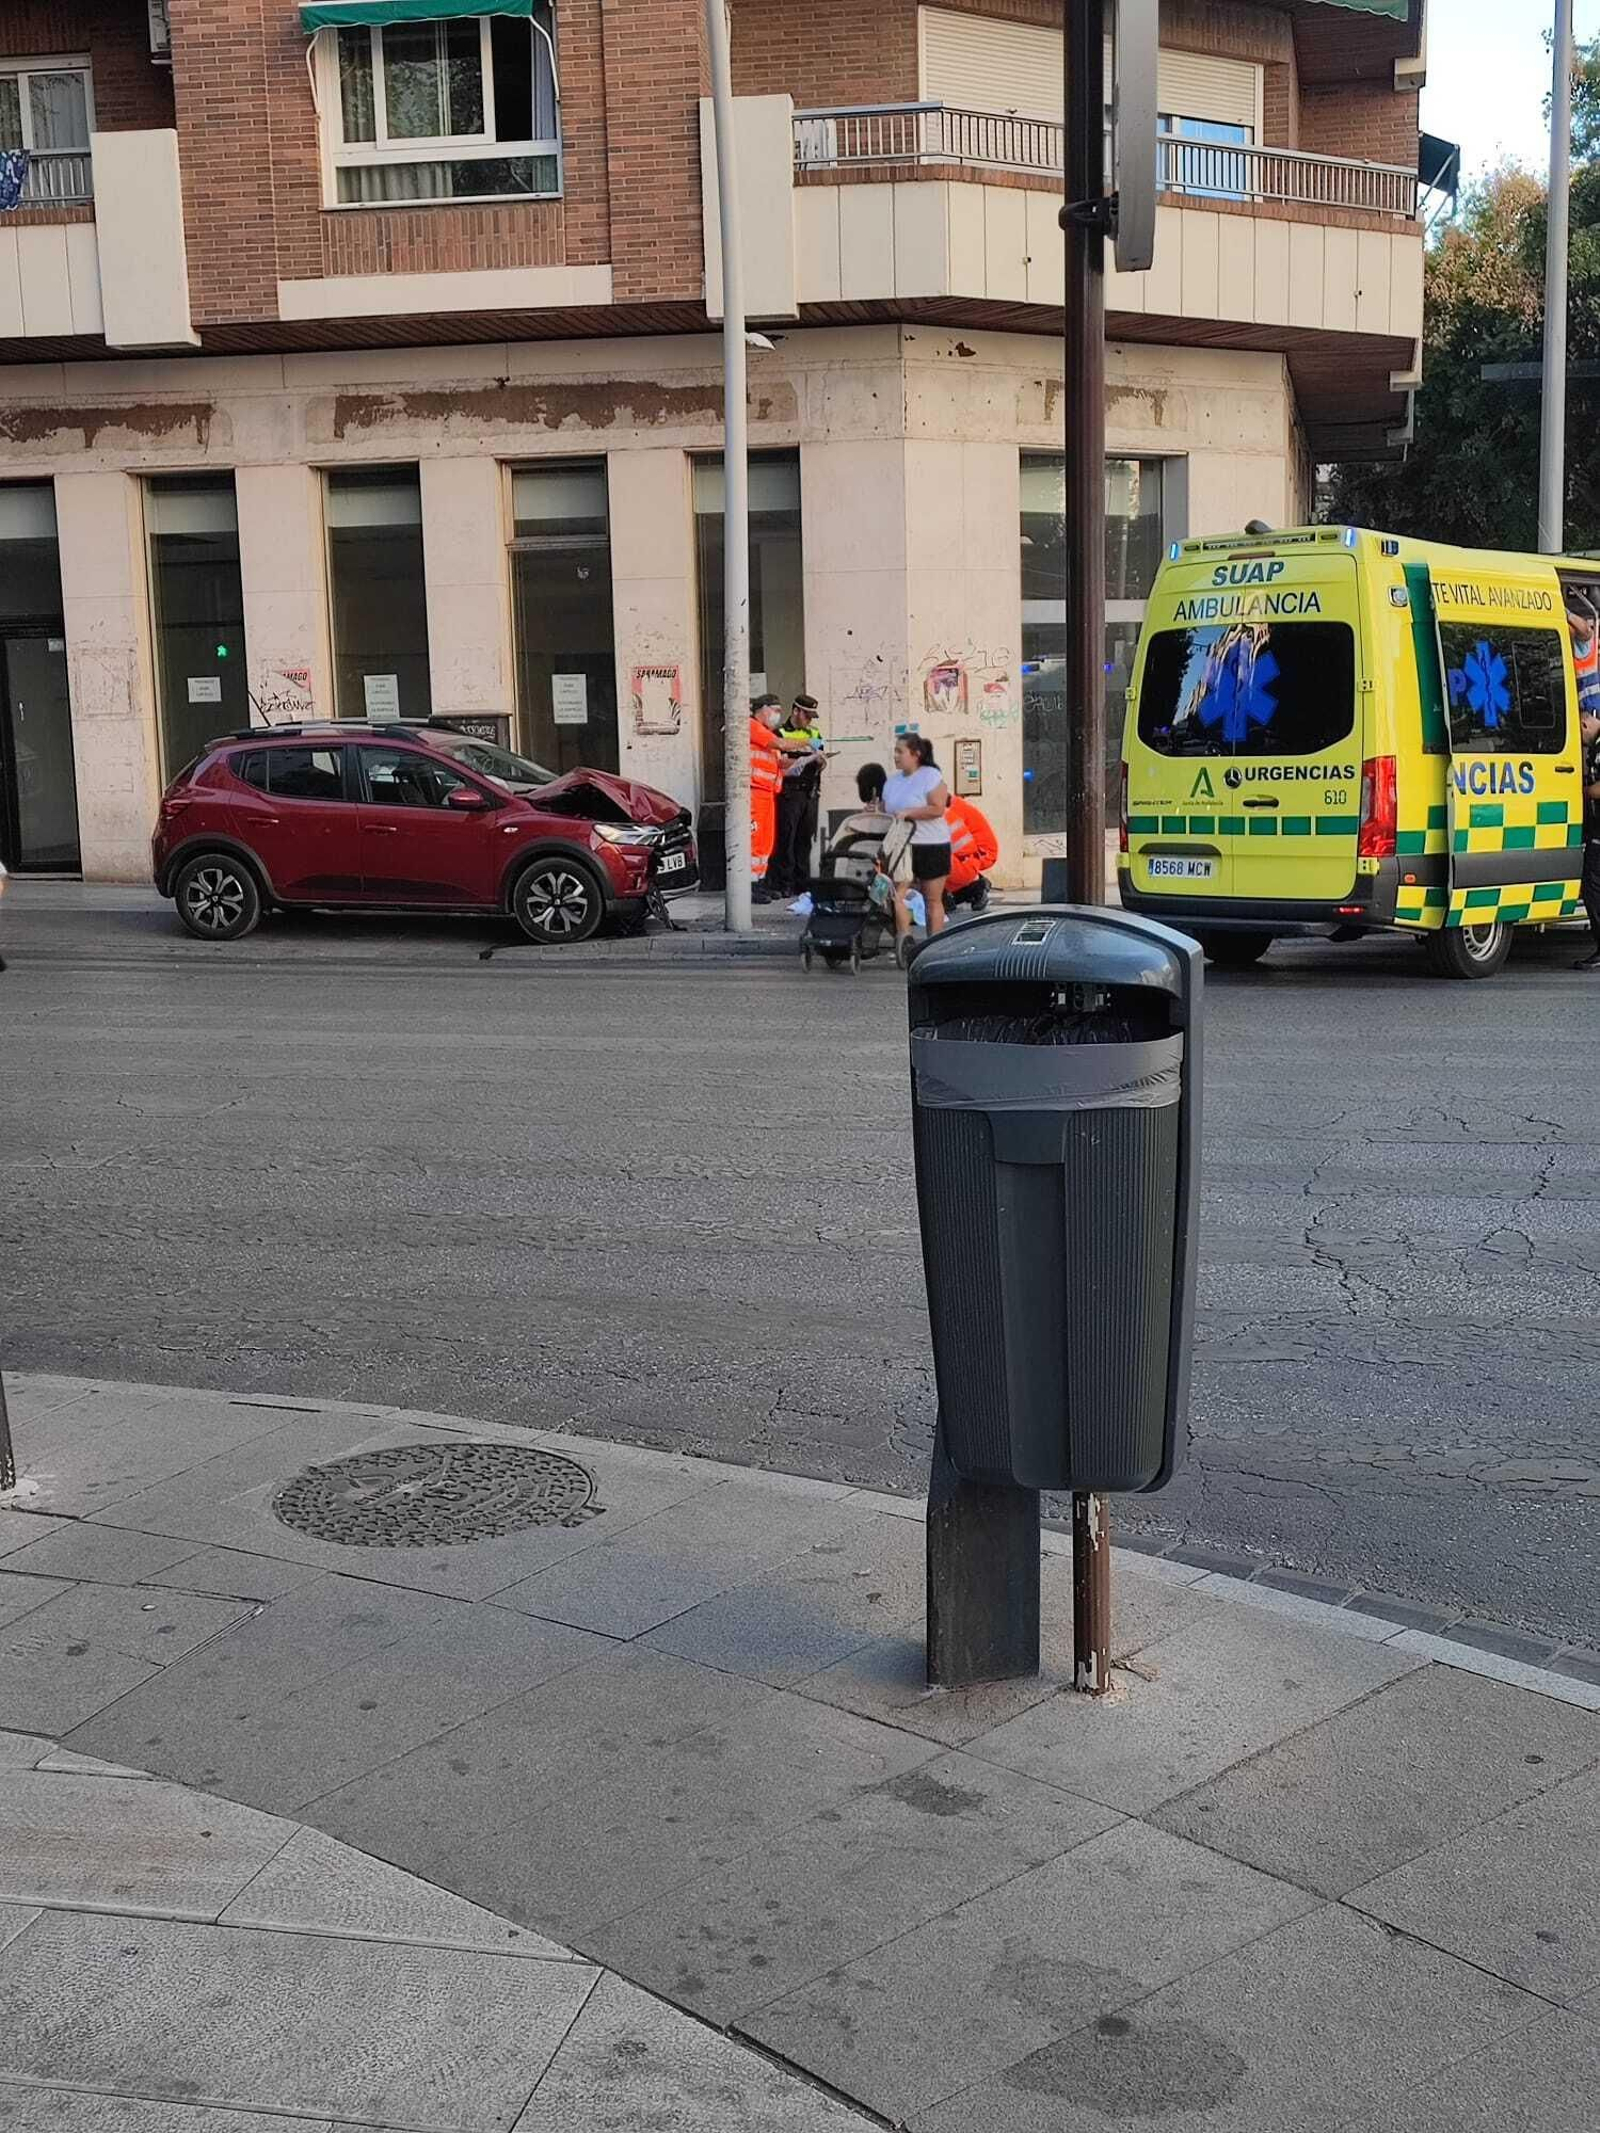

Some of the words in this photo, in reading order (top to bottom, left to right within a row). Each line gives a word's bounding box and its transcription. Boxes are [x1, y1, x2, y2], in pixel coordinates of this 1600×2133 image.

[1212, 561, 1285, 586] SUAP
[1173, 591, 1321, 622] AMBULANCIA
[1449, 584, 1485, 606] VITAL
[1488, 586, 1552, 611] AVANZADO
[1244, 764, 1356, 781] URGENCIAS
[1324, 789, 1347, 805] 610
[1155, 860, 1184, 876] 8568
